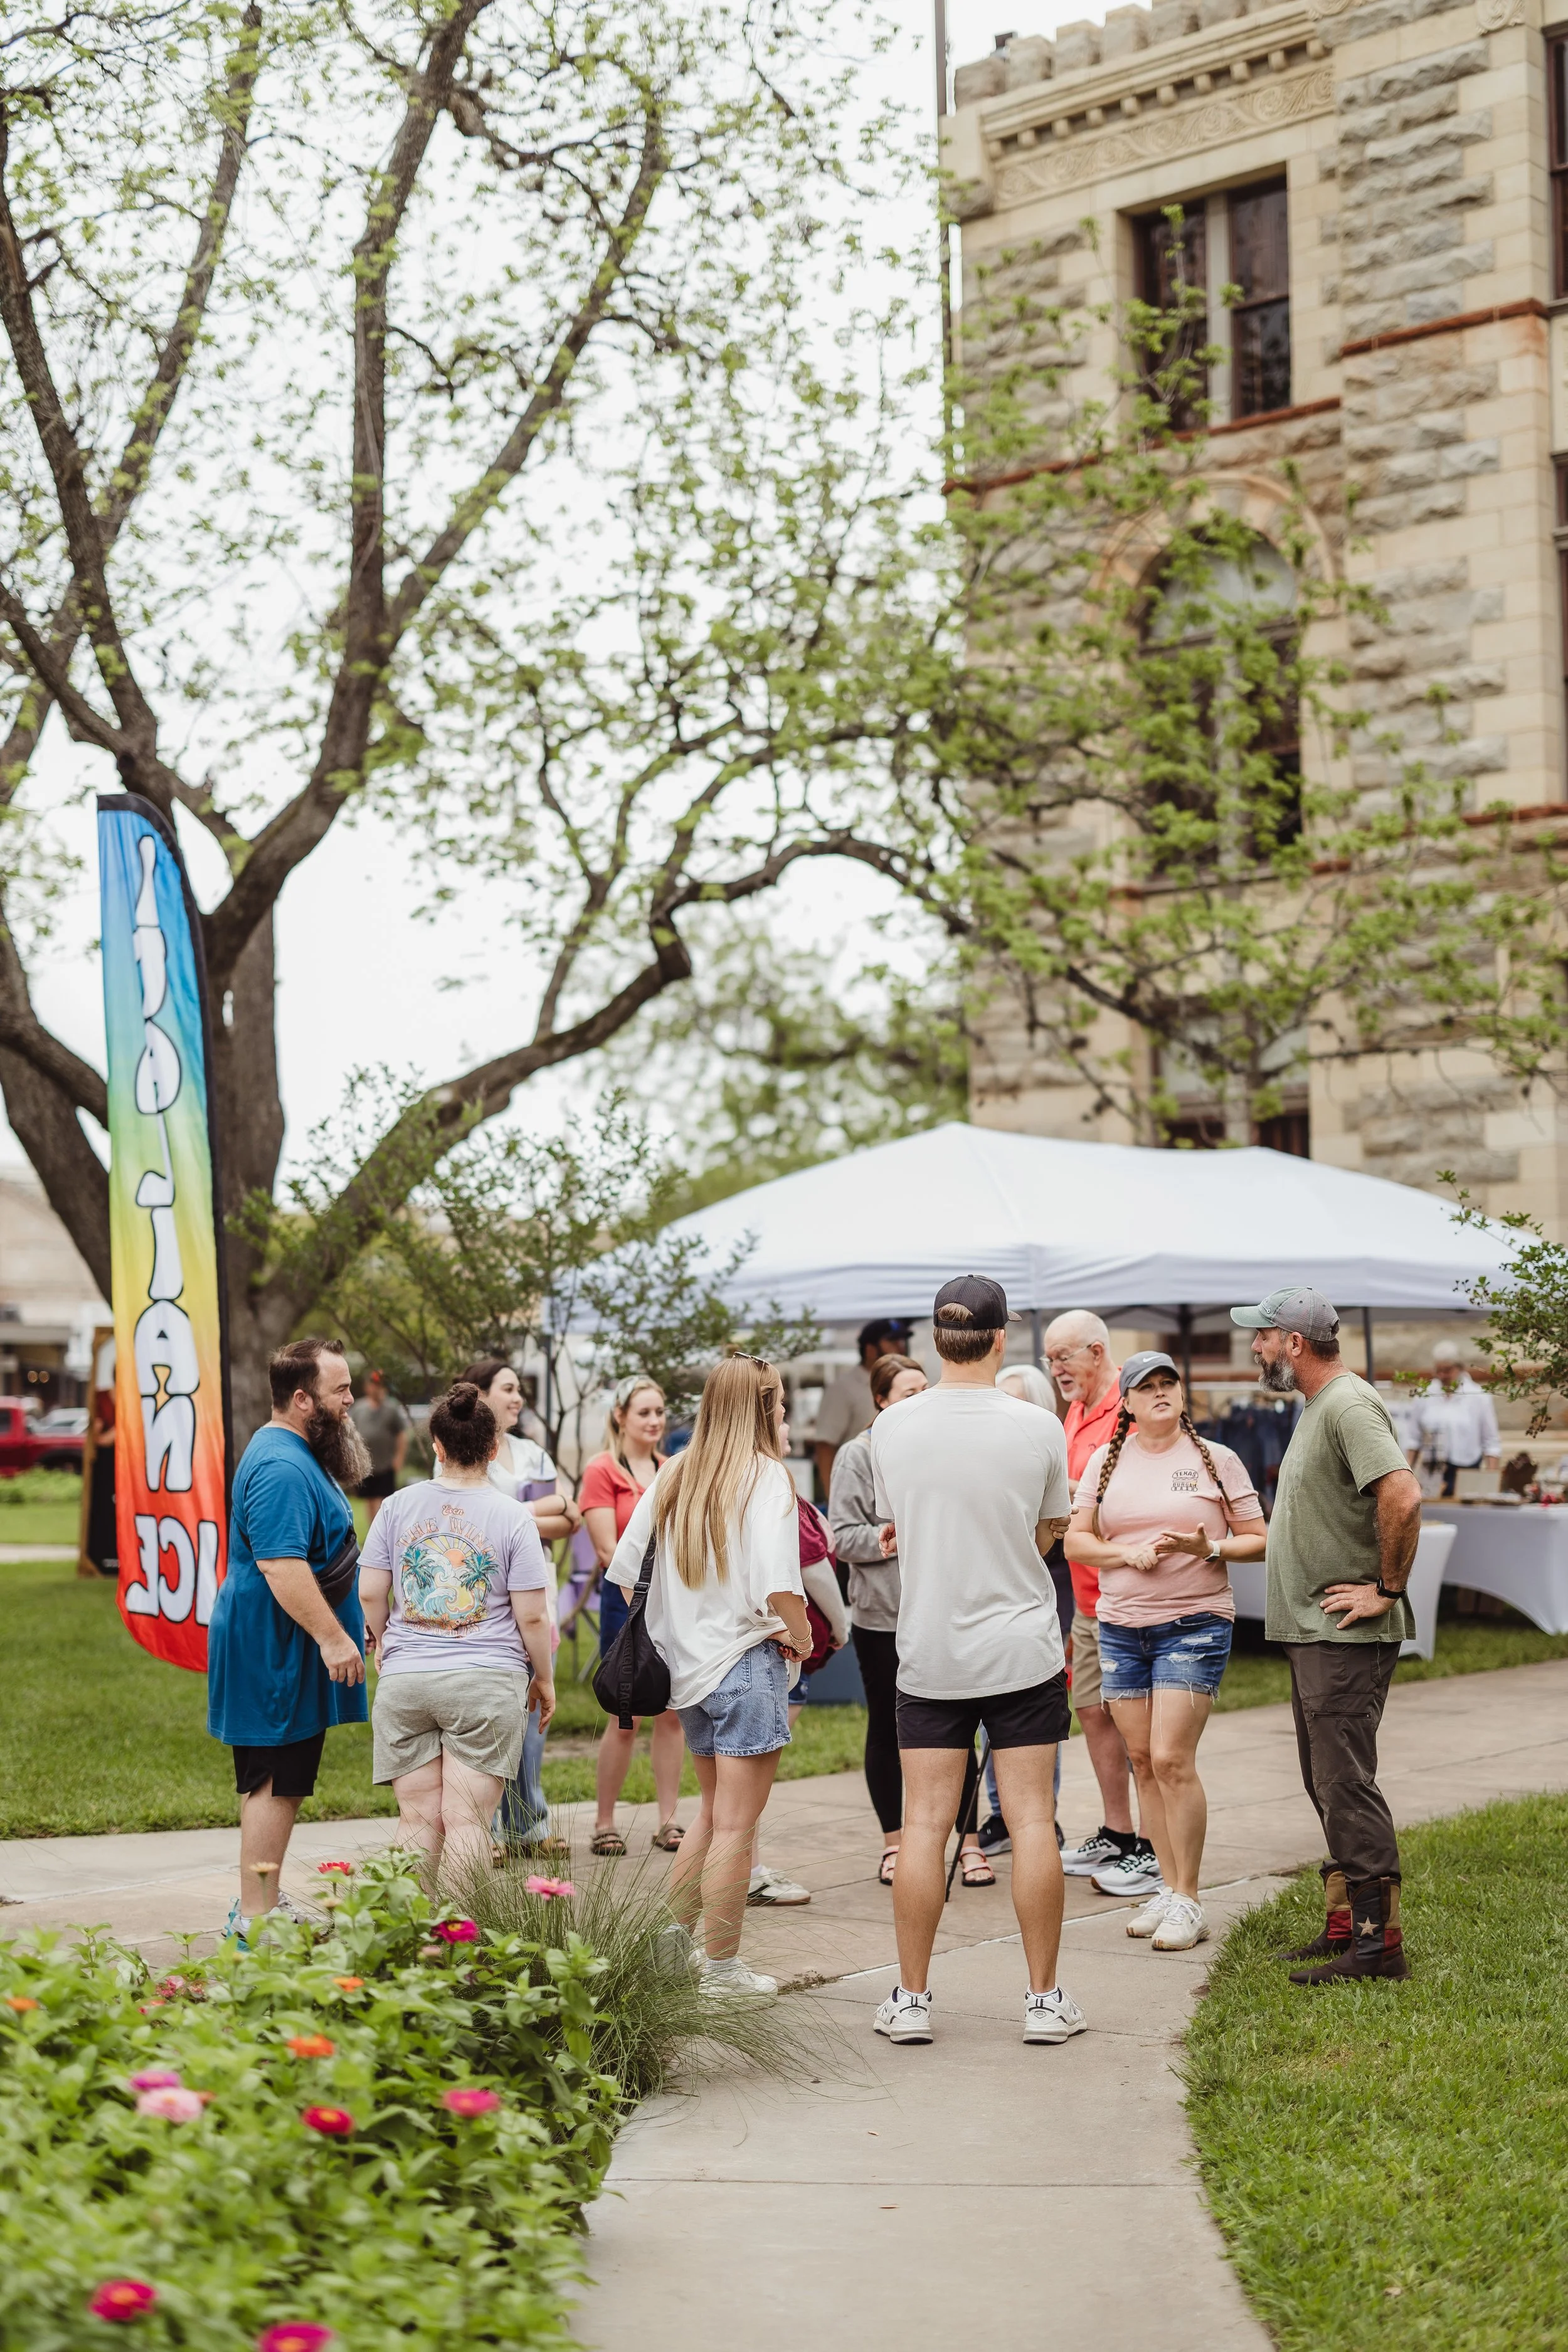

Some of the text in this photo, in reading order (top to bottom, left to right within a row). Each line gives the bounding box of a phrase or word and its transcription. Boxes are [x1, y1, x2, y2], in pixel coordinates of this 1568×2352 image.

[442, 1505, 464, 1515] Even
[395, 1517, 497, 1561] THE WIND
